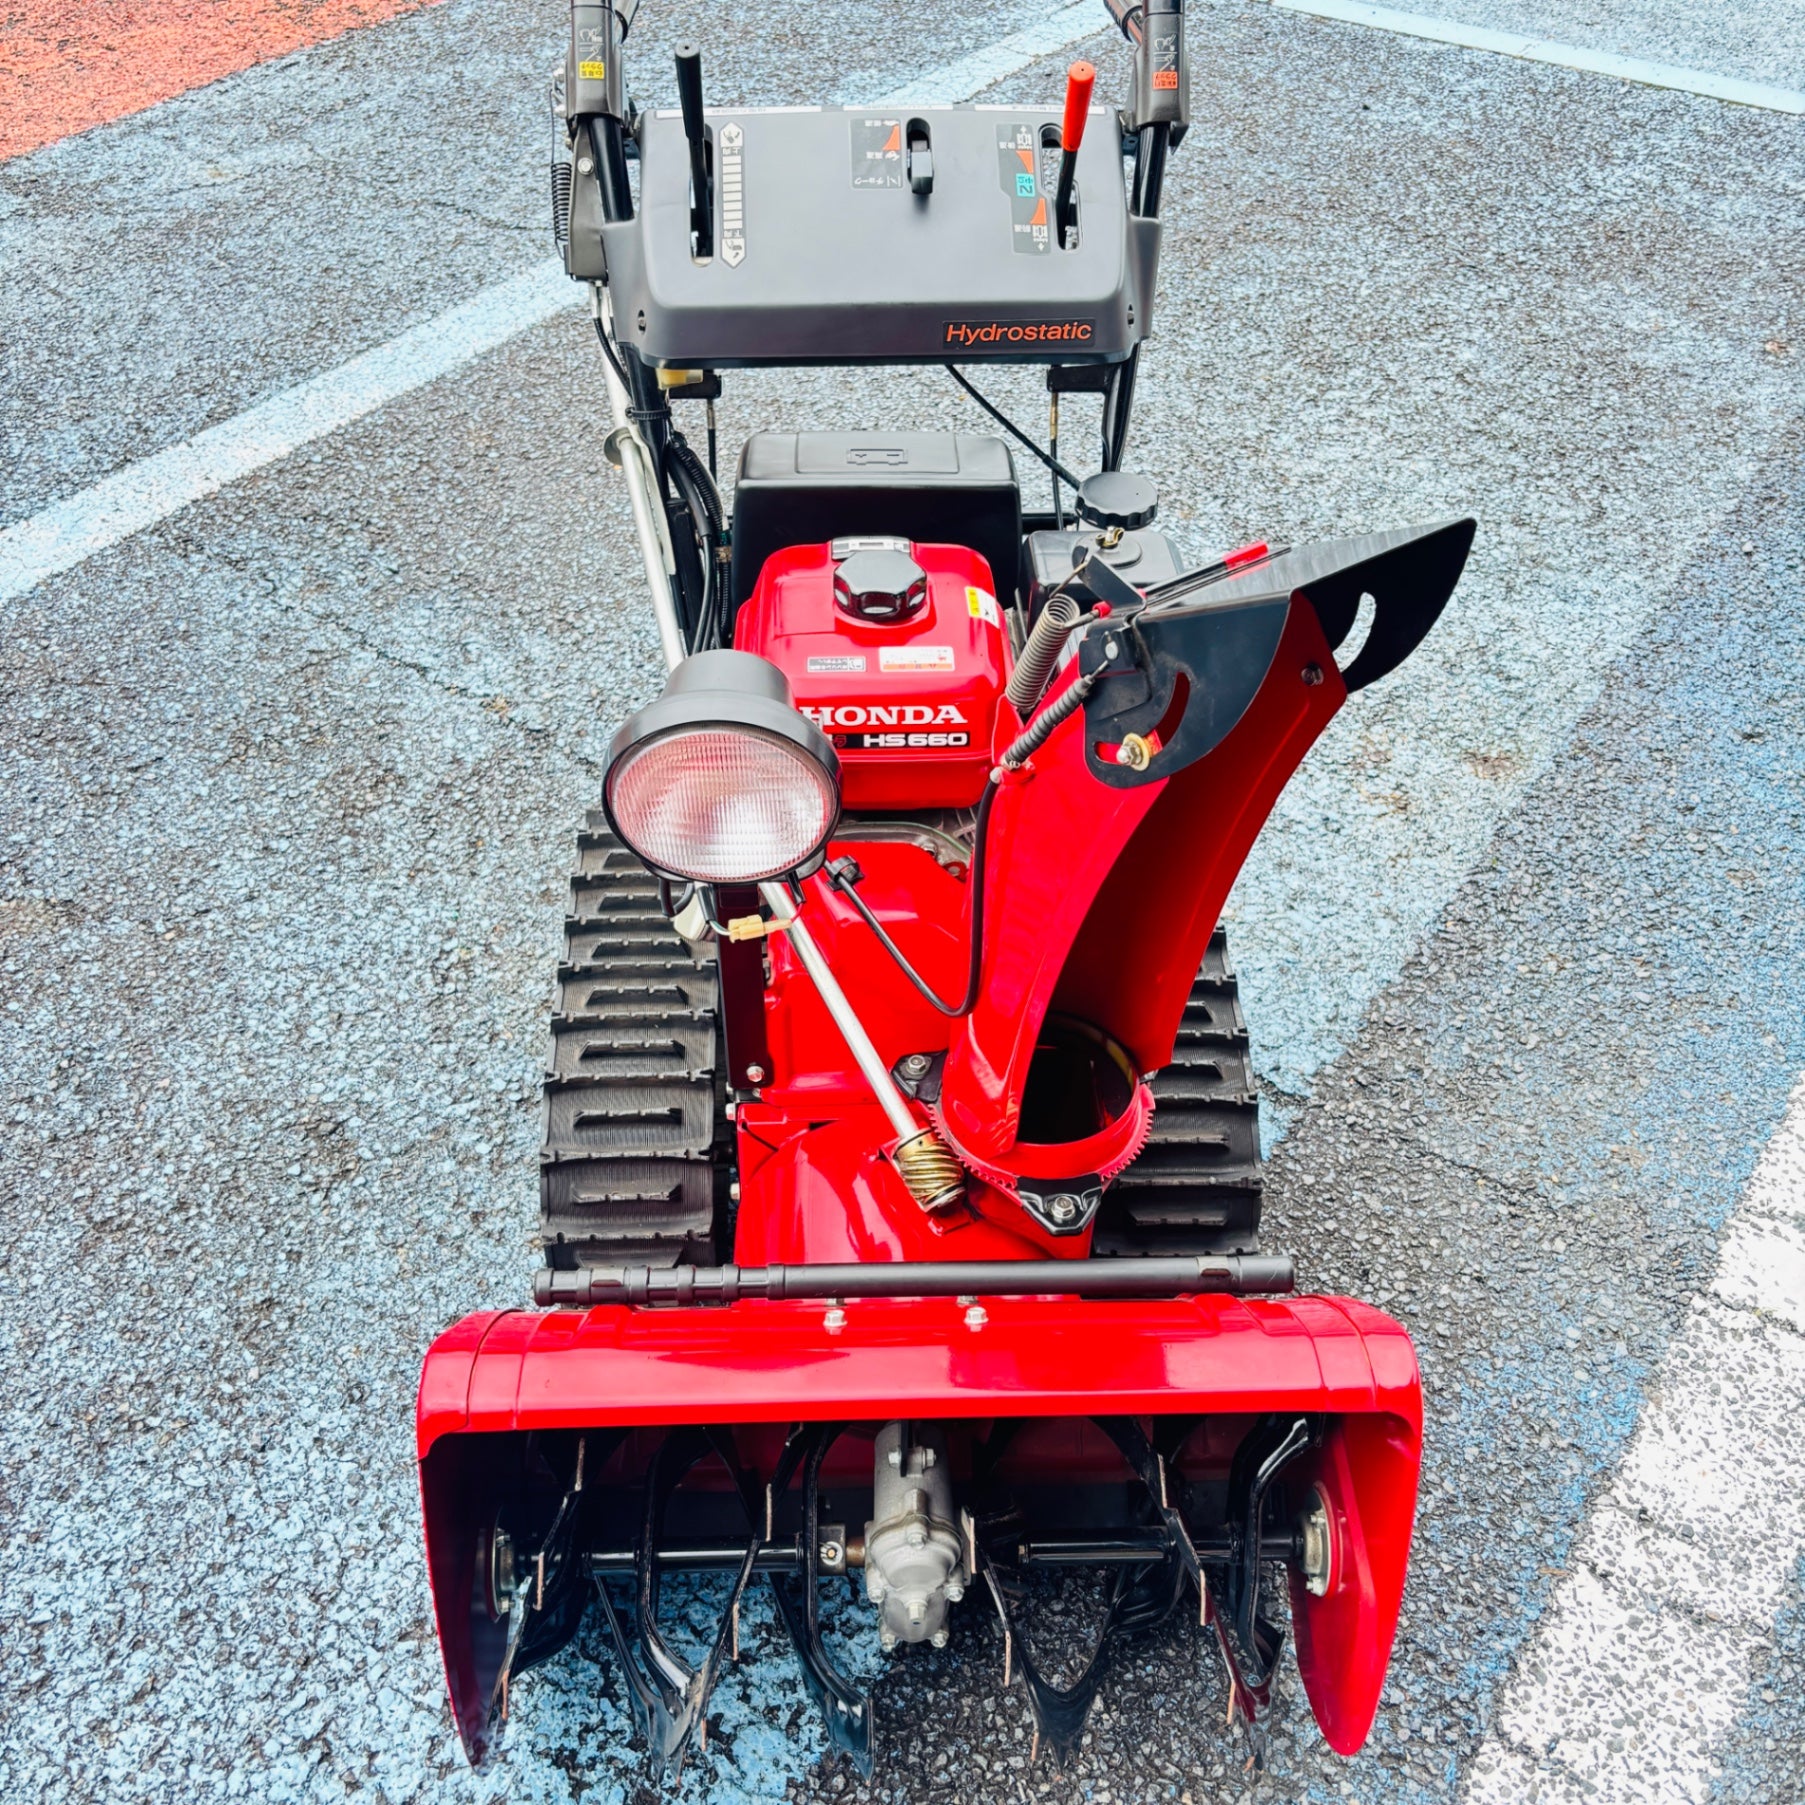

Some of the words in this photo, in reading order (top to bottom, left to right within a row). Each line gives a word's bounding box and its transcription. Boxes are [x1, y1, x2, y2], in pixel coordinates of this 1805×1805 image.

[946, 321, 1092, 346] Hydrostatic
[798, 704, 968, 726] HONDA
[863, 732, 968, 747] HS660
